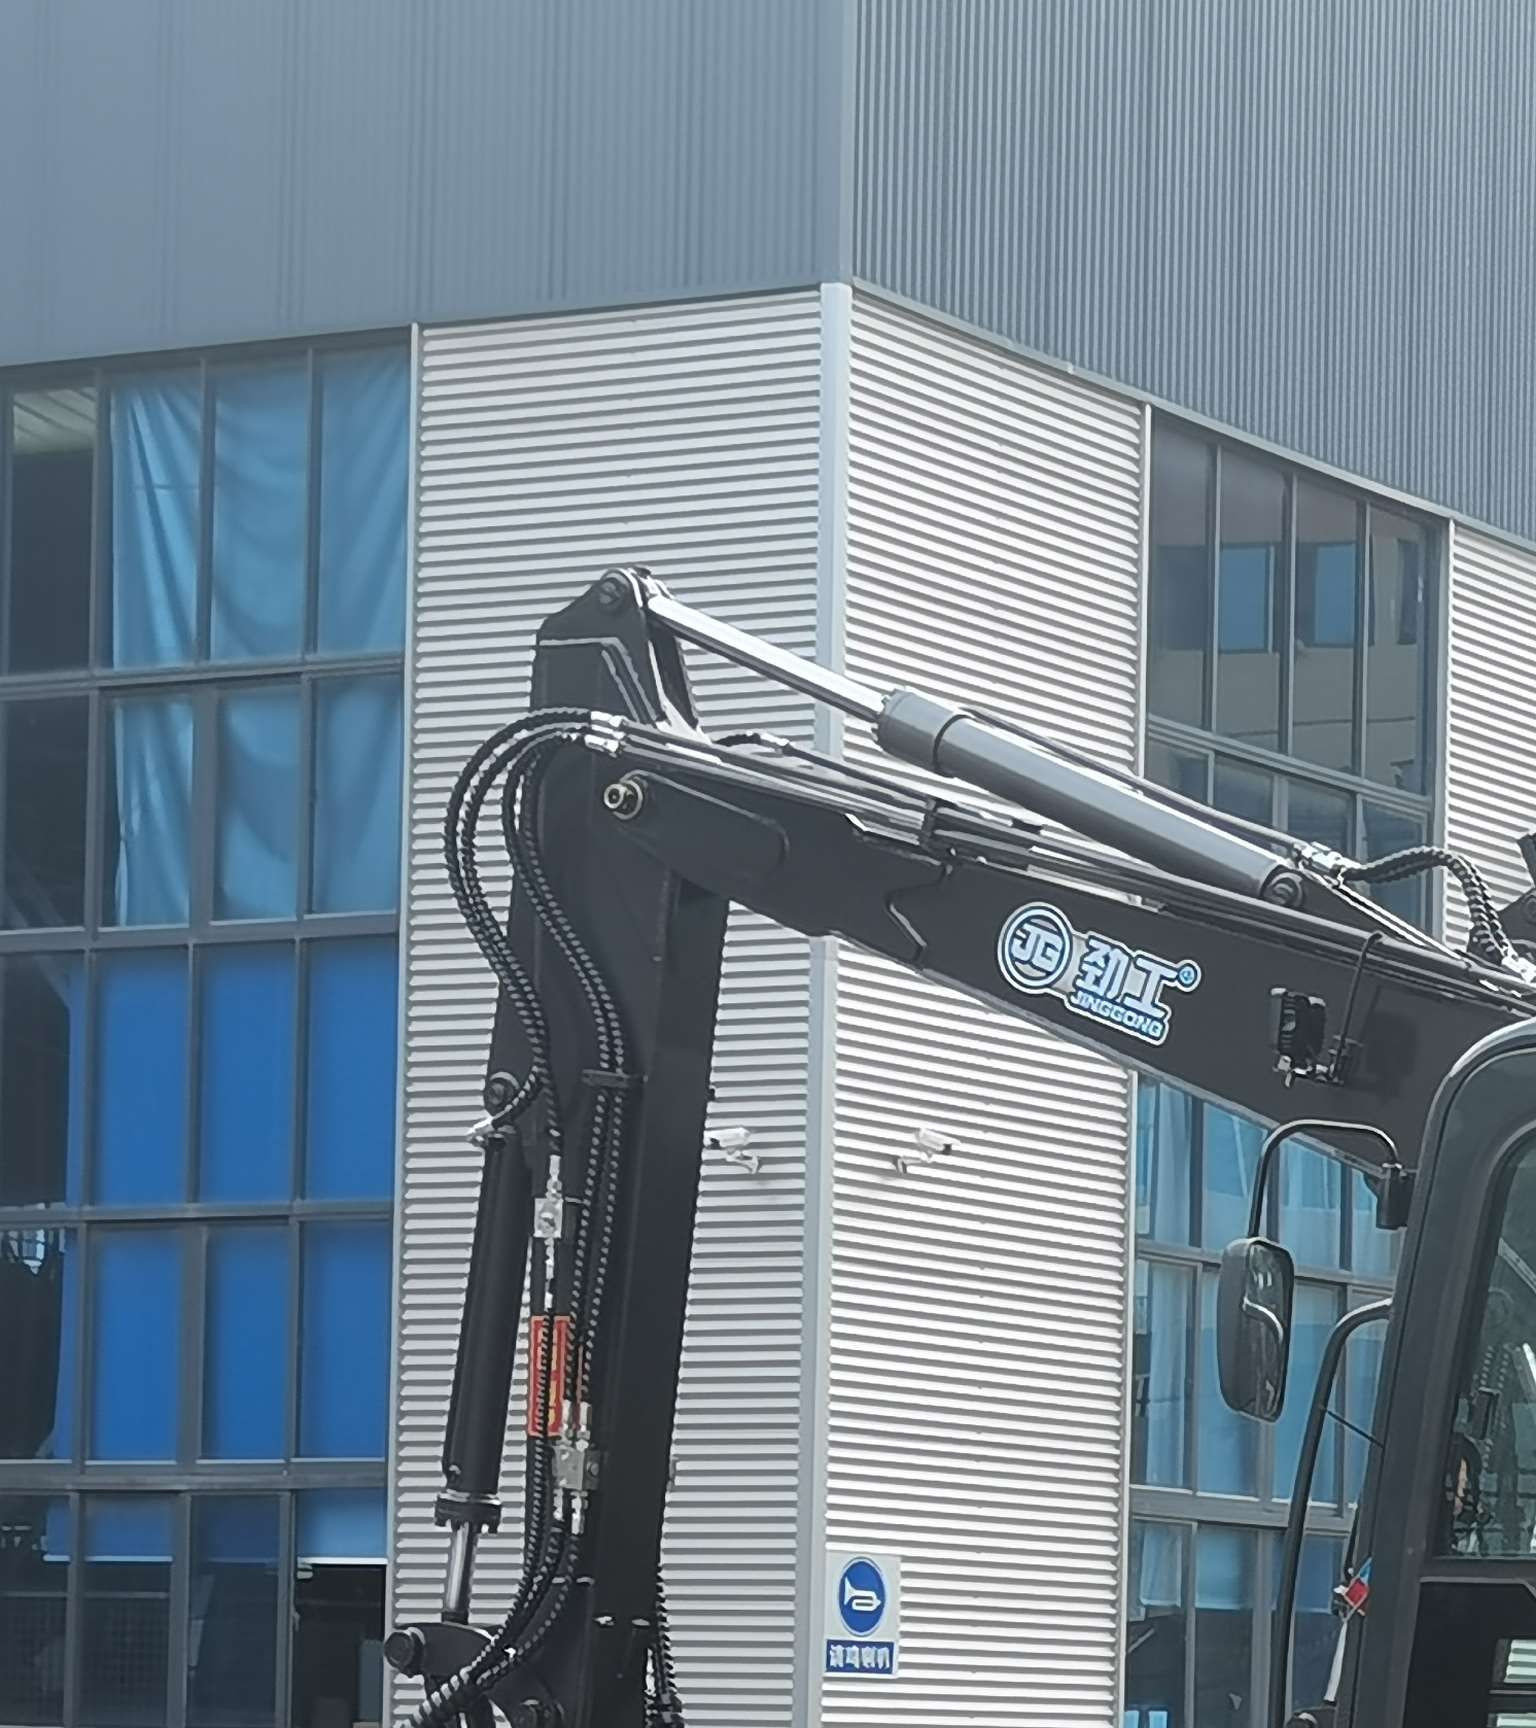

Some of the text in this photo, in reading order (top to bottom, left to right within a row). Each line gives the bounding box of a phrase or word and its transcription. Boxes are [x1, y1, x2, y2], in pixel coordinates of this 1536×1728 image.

[1010, 922, 1064, 973] JG
[1075, 936, 1179, 1019] 劲工
[1070, 988, 1163, 1037] JINGGONG
